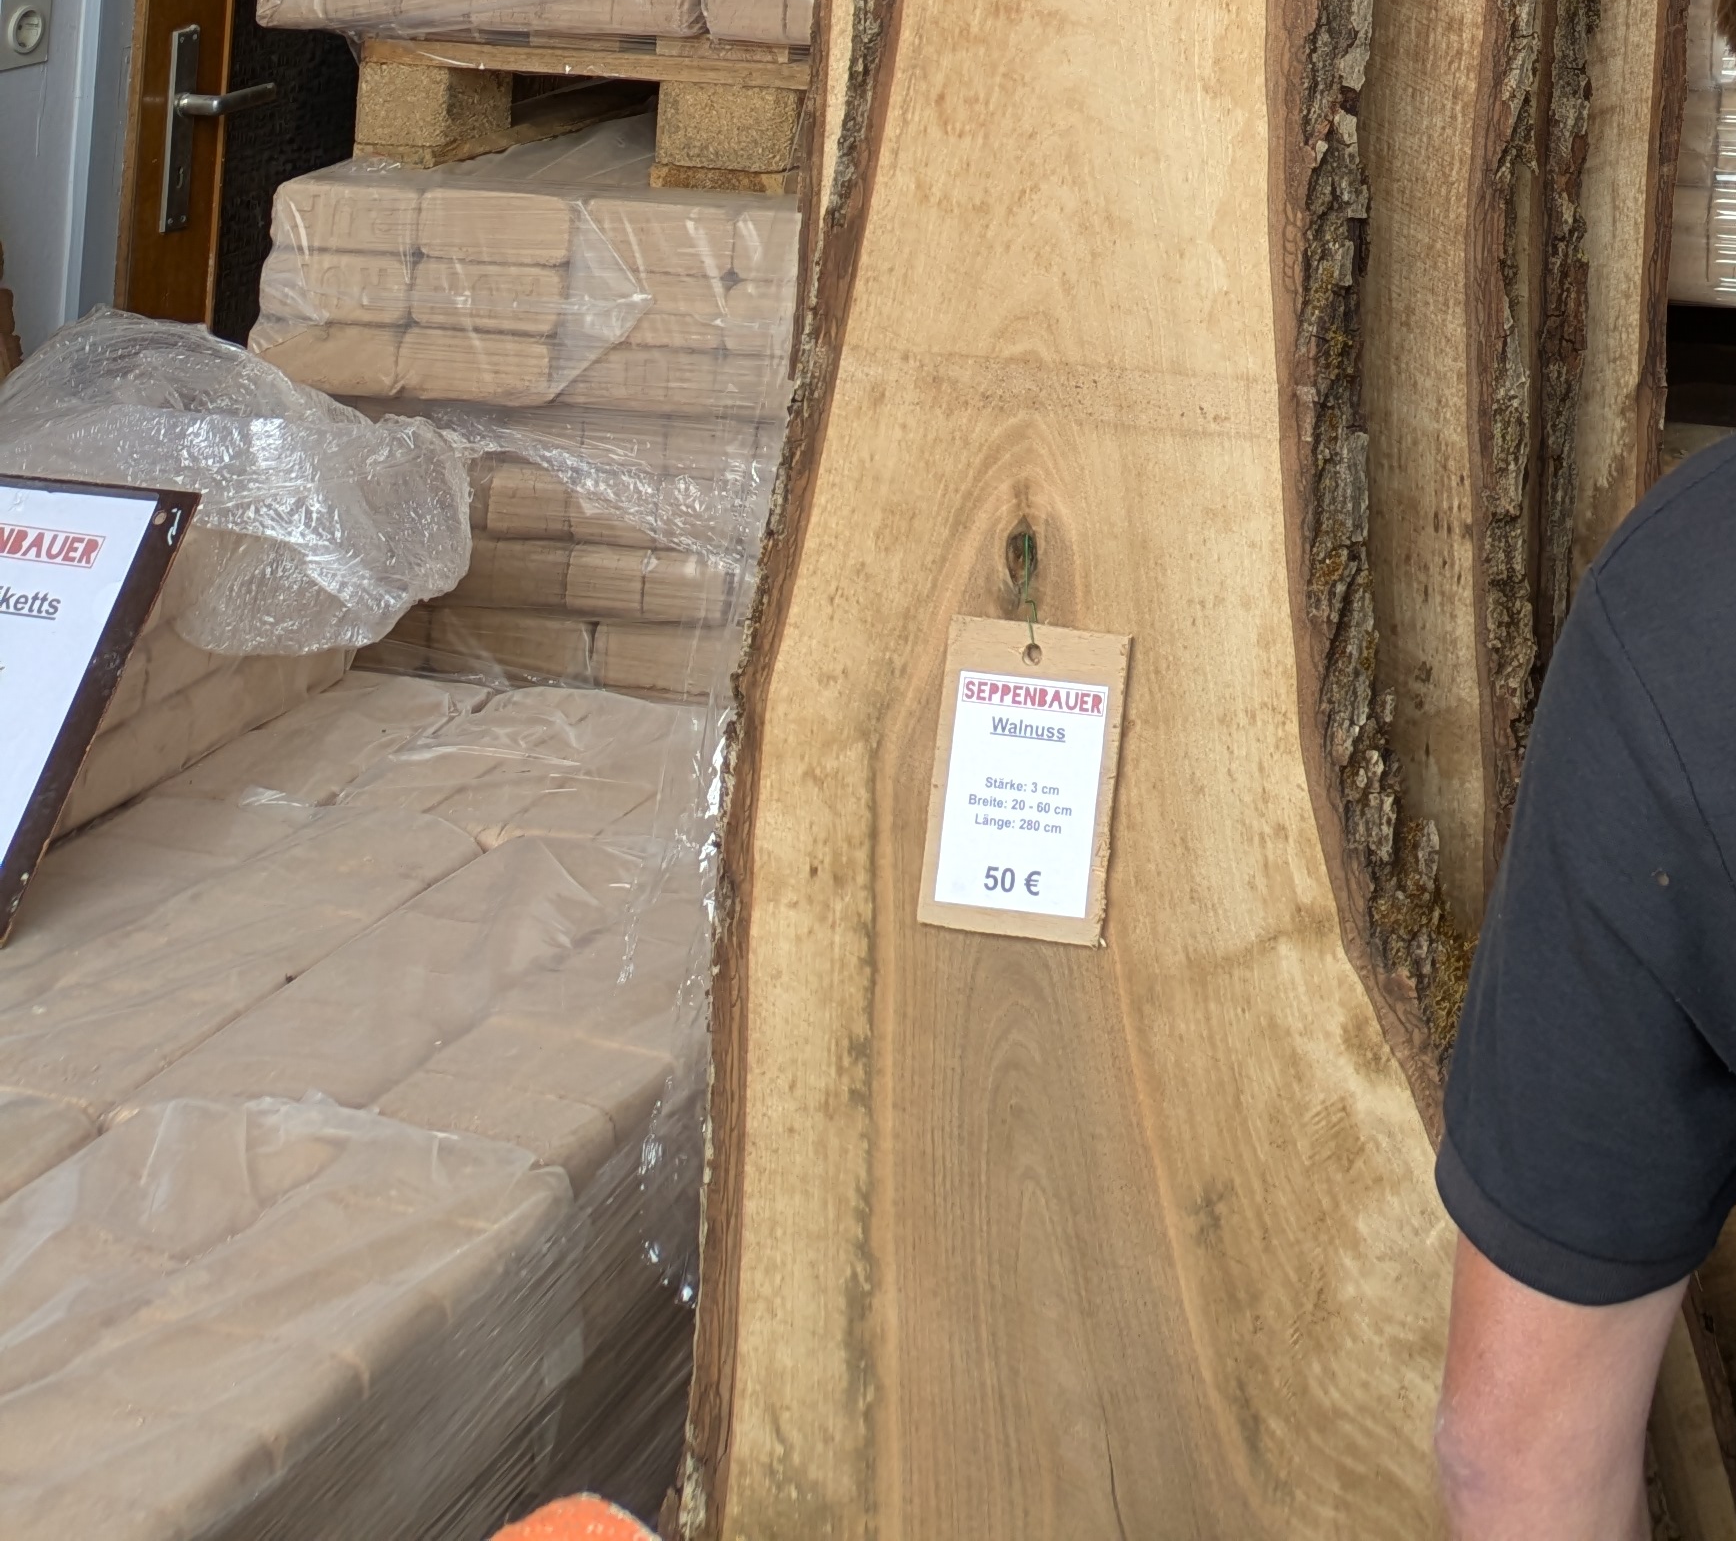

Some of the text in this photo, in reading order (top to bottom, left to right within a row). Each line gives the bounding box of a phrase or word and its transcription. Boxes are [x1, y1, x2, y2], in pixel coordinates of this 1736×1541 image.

[964, 679, 1104, 715] SEPPENBAUER
[991, 716, 1067, 740] Walnuss
[984, 776, 1060, 796] Stärke: 3 cm
[968, 793, 1008, 809] Breite:
[1011, 798, 1026, 811] 20
[1036, 801, 1051, 814] 60
[1053, 805, 1073, 817] cm
[975, 813, 1062, 835] Länge: 280 cm
[983, 866, 1042, 896] 50 €
